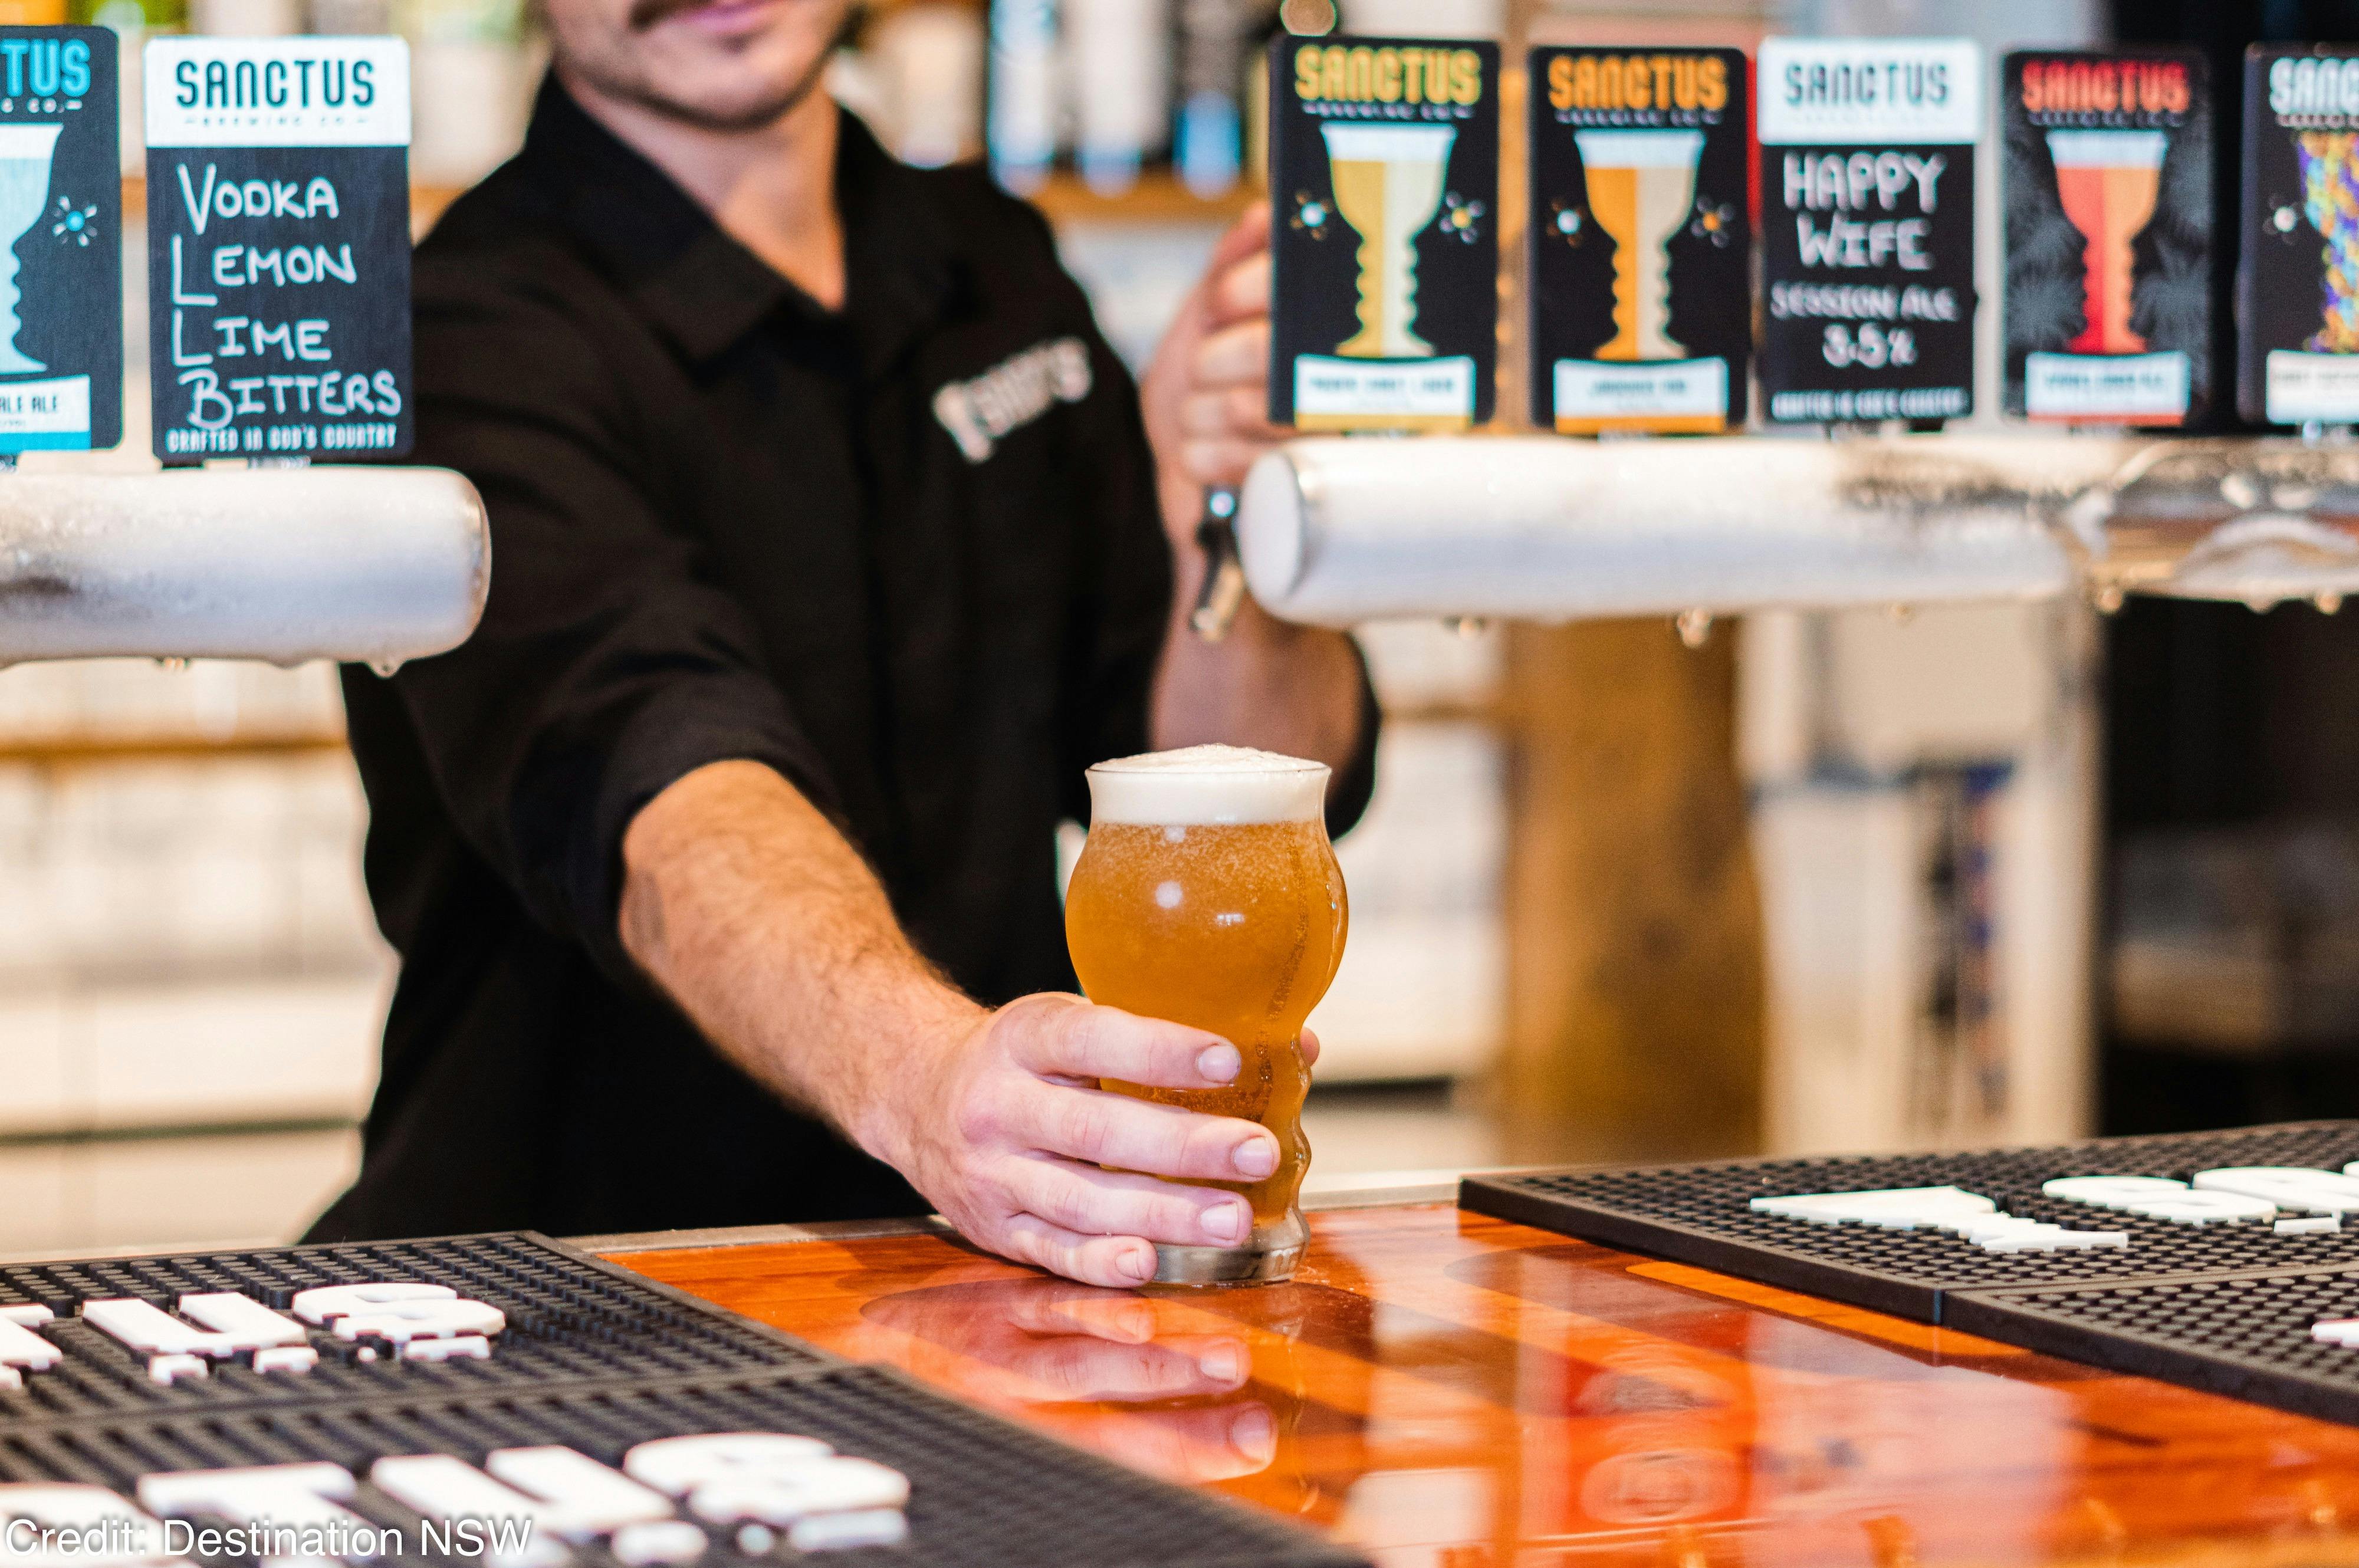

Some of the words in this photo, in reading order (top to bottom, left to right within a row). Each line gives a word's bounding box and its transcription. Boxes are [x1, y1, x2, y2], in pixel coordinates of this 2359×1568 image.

[0, 38, 91, 97] TUS
[176, 60, 374, 109] SANCTUS
[1295, 44, 1481, 105] SANCTUS
[1548, 56, 1728, 111] SANCTUS
[1785, 61, 1949, 107] SANCTUS
[2022, 61, 2190, 113] SANCTUS
[178, 163, 339, 235] VODKA
[1783, 150, 1947, 214] HAPPY
[1797, 211, 1937, 271] WIFE
[172, 235, 357, 307] LEMON
[173, 310, 331, 366] LIME
[178, 368, 402, 430] BITTERS
[166, 427, 238, 453] CRAFTED
[321, 422, 397, 449] COUNTRY
